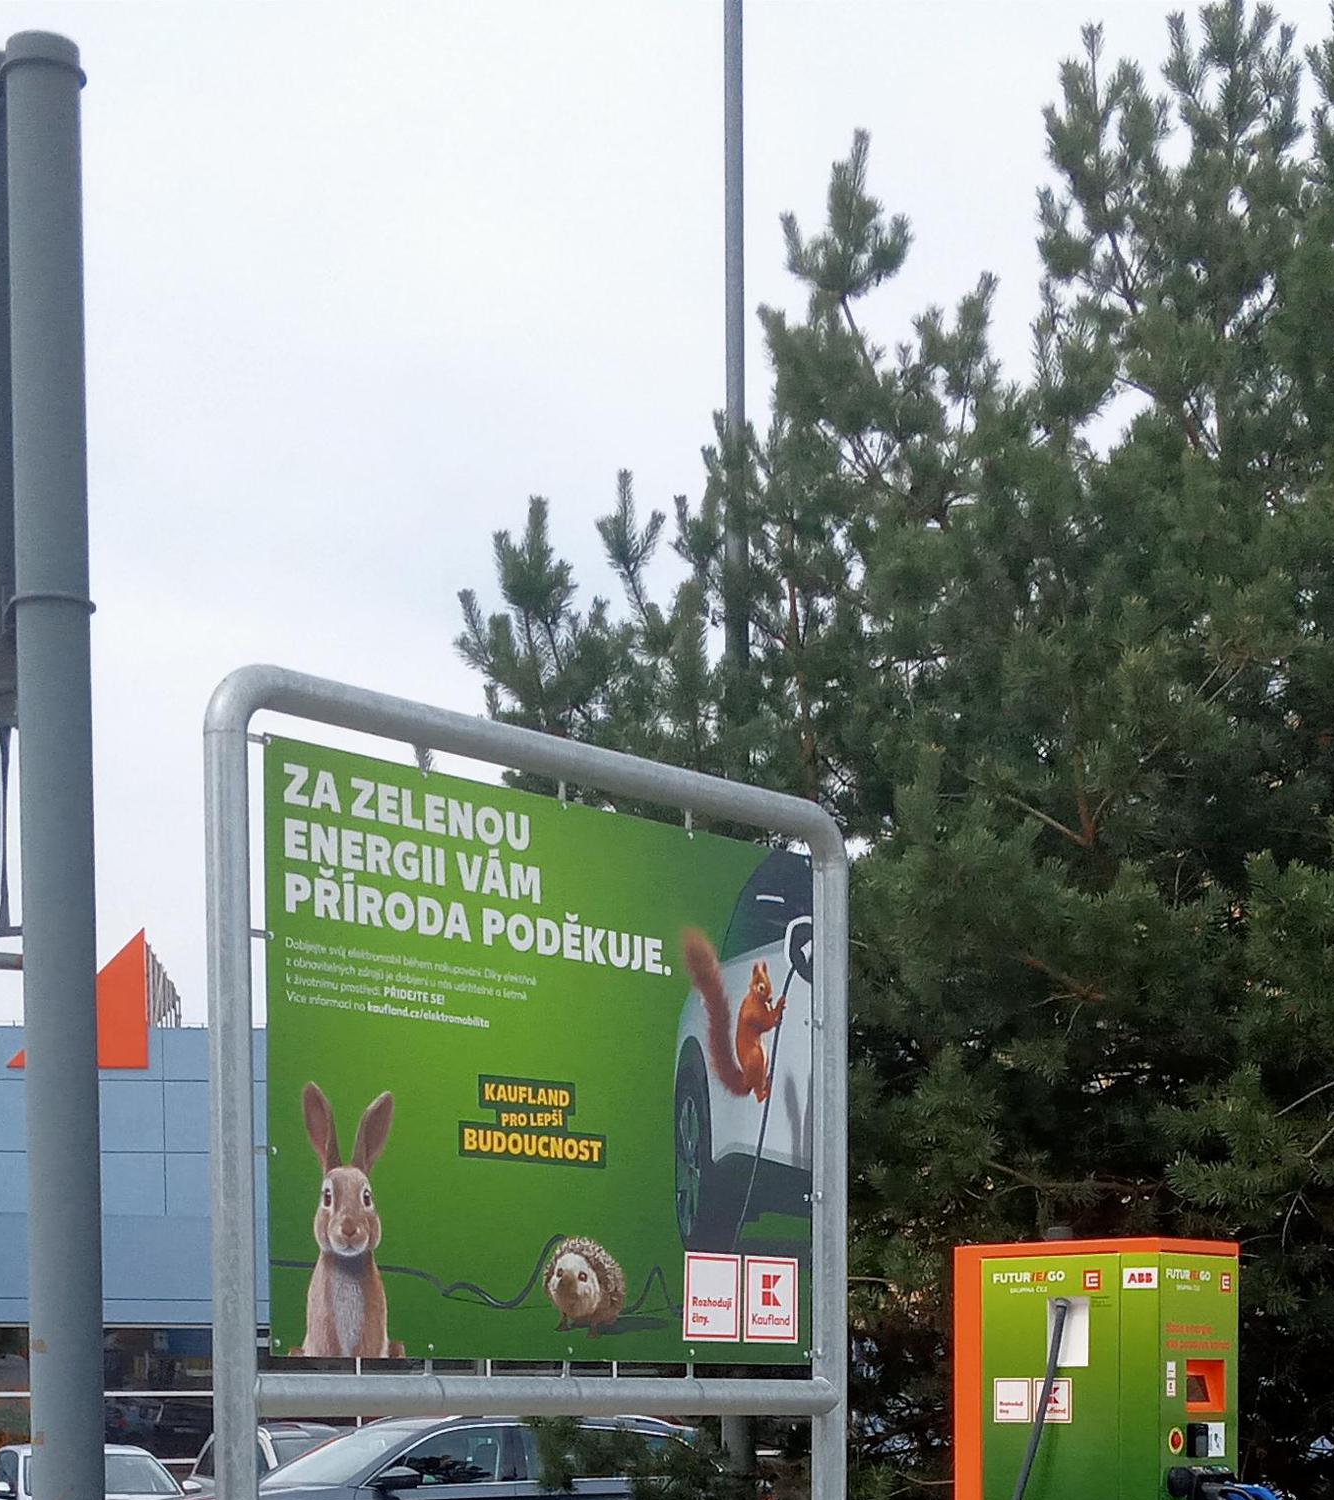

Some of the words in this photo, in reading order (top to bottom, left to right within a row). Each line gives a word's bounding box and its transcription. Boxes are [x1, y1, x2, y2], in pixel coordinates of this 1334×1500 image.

[283, 762, 342, 814] ZA
[350, 776, 530, 852] ZELENOU
[284, 817, 446, 887] ENERGII
[456, 848, 541, 905] VÁM
[284, 867, 472, 943] PŘÍRODA
[482, 908, 673, 977] PODĚKUJE.
[484, 1083, 570, 1107] KAUFLAND
[501, 1113, 527, 1127] PRO
[529, 1109, 563, 1127] LEPŠÍ
[464, 1128, 603, 1162] BUDOUCNOST
[1128, 1272, 1153, 1284] ABB
[751, 1313, 790, 1326] Kaufland
